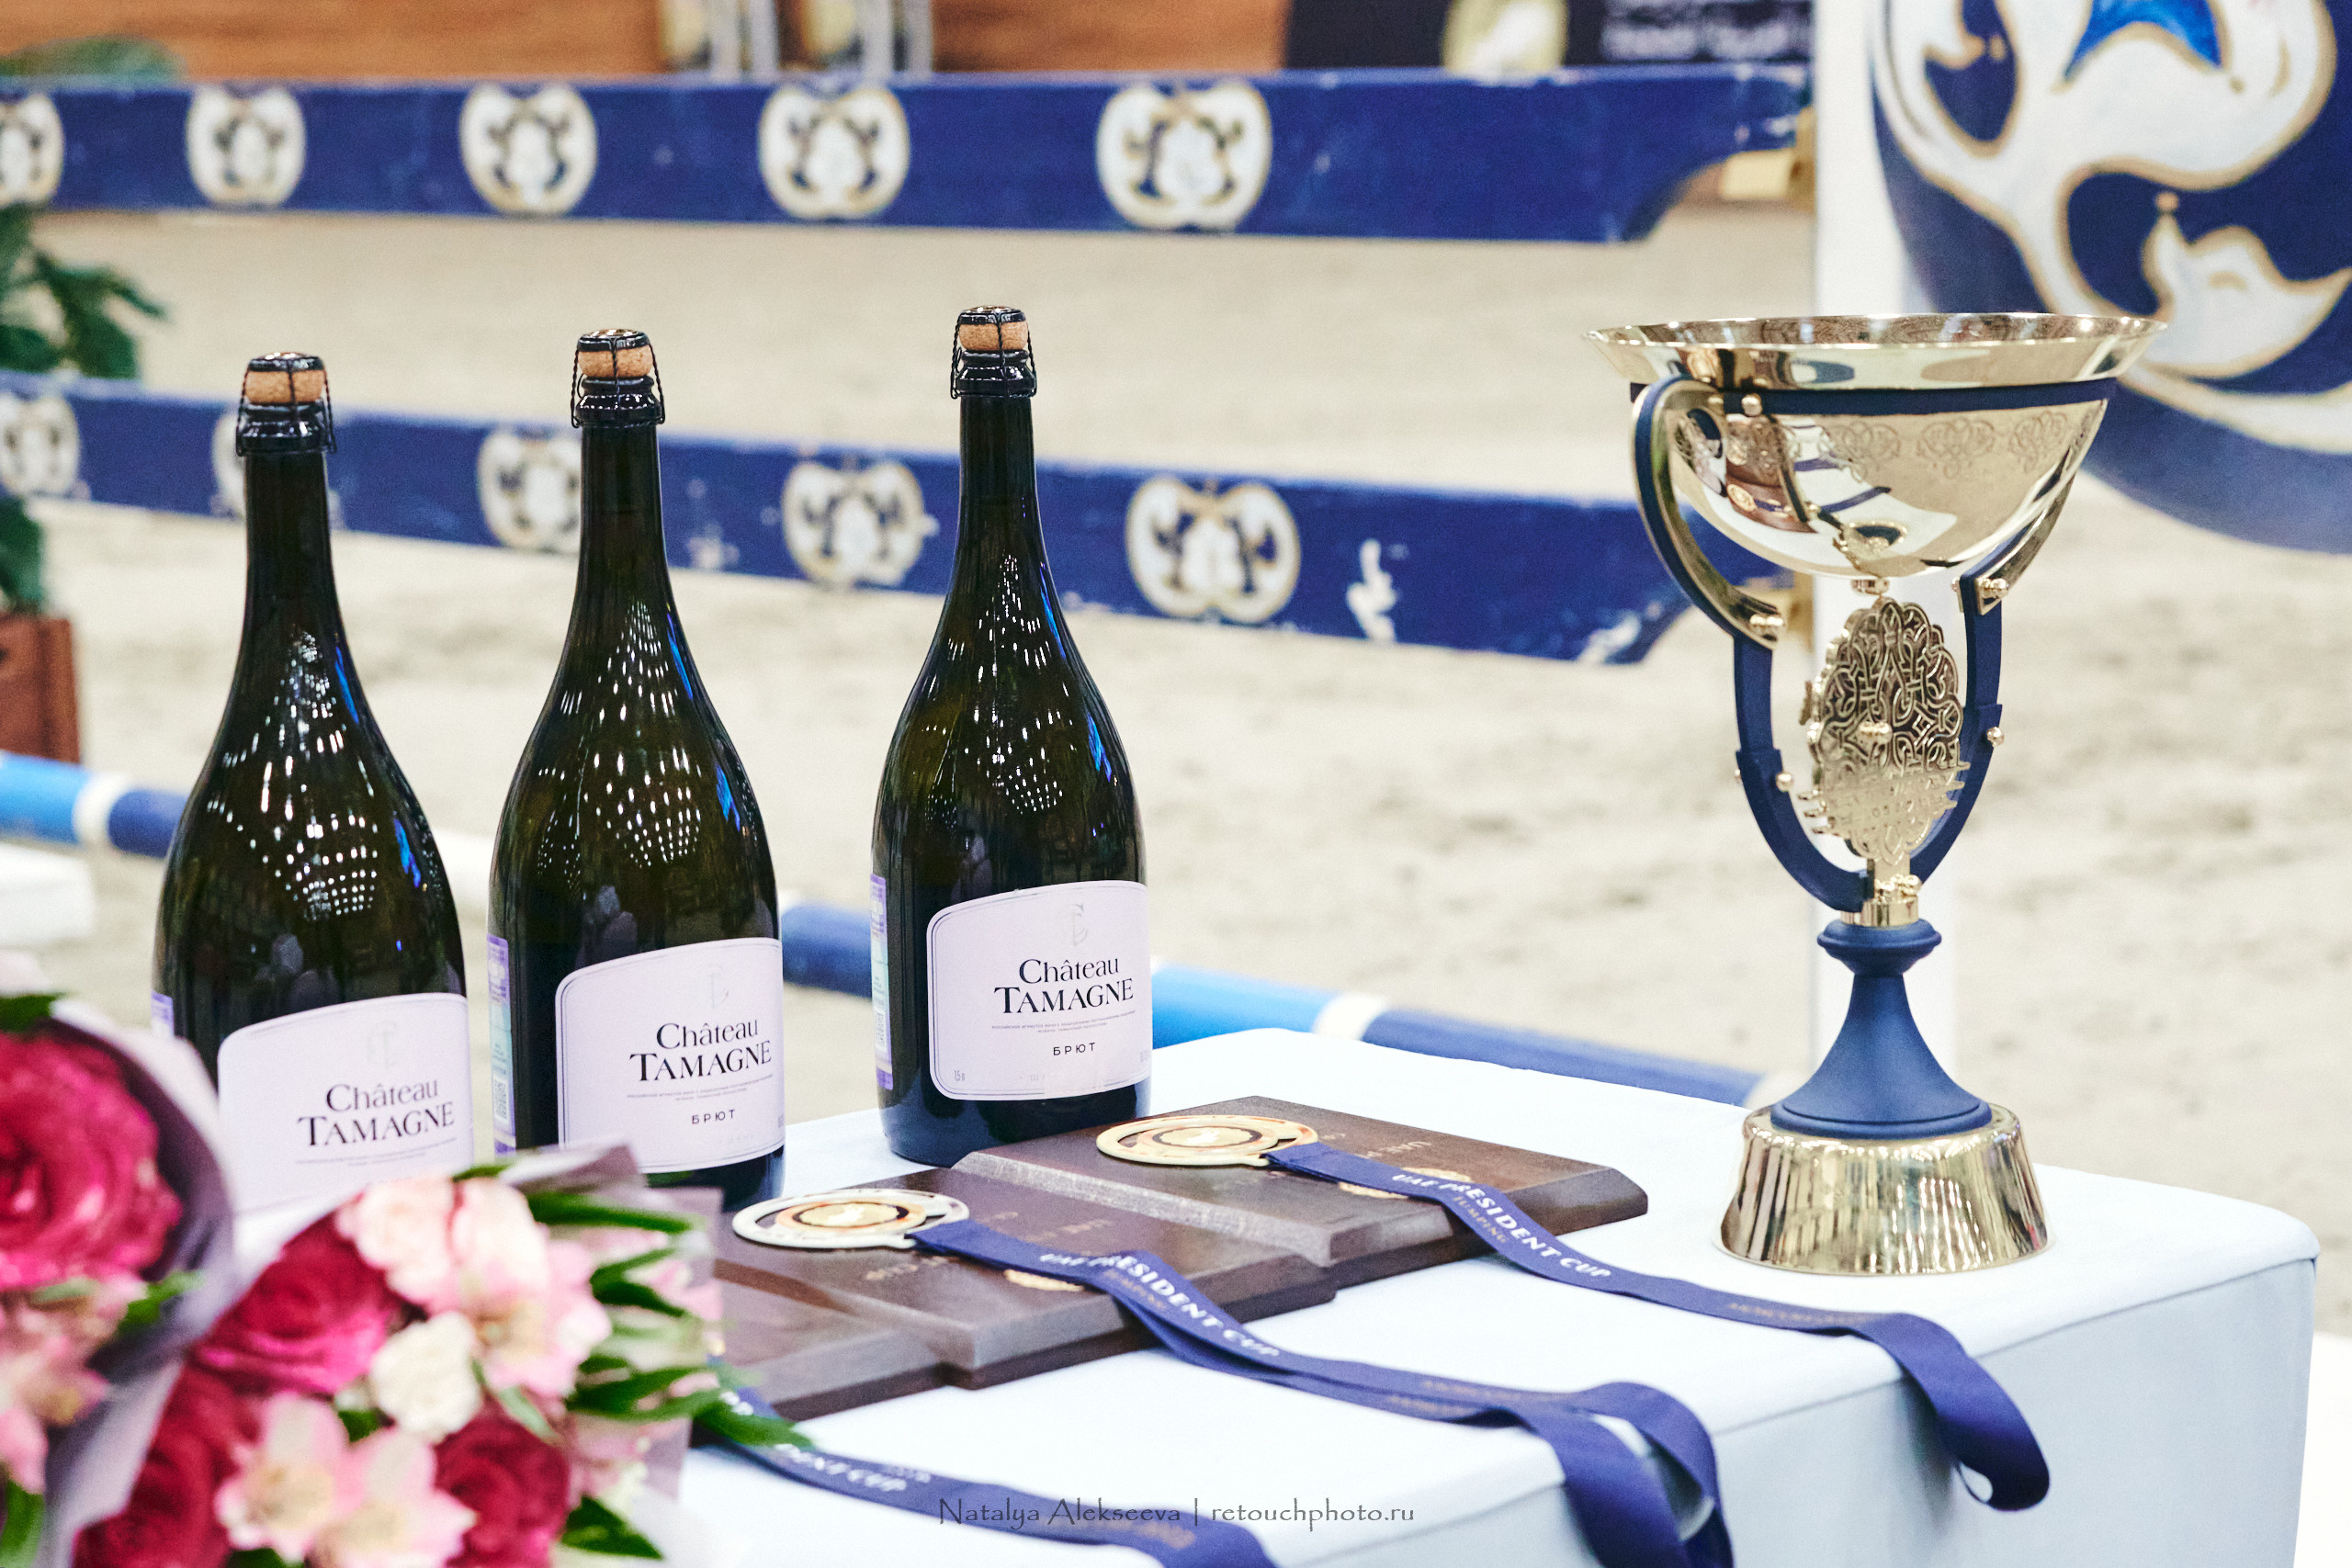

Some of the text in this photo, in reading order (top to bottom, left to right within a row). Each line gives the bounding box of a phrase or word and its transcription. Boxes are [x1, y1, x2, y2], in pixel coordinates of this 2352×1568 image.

[1019, 957, 1119, 984] Château
[993, 977, 1135, 1014] TAMAGNE
[656, 1019, 759, 1050] Château
[1053, 1042, 1096, 1056] БРЮТ
[629, 1040, 773, 1082] TAMAGNE
[326, 1079, 438, 1112] Château
[297, 1101, 455, 1146] TAMAGNE
[692, 1109, 735, 1125] БРЮТ
[1438, 1181, 1562, 1258] PRESIDENT
[1559, 1257, 1611, 1278] CUP
